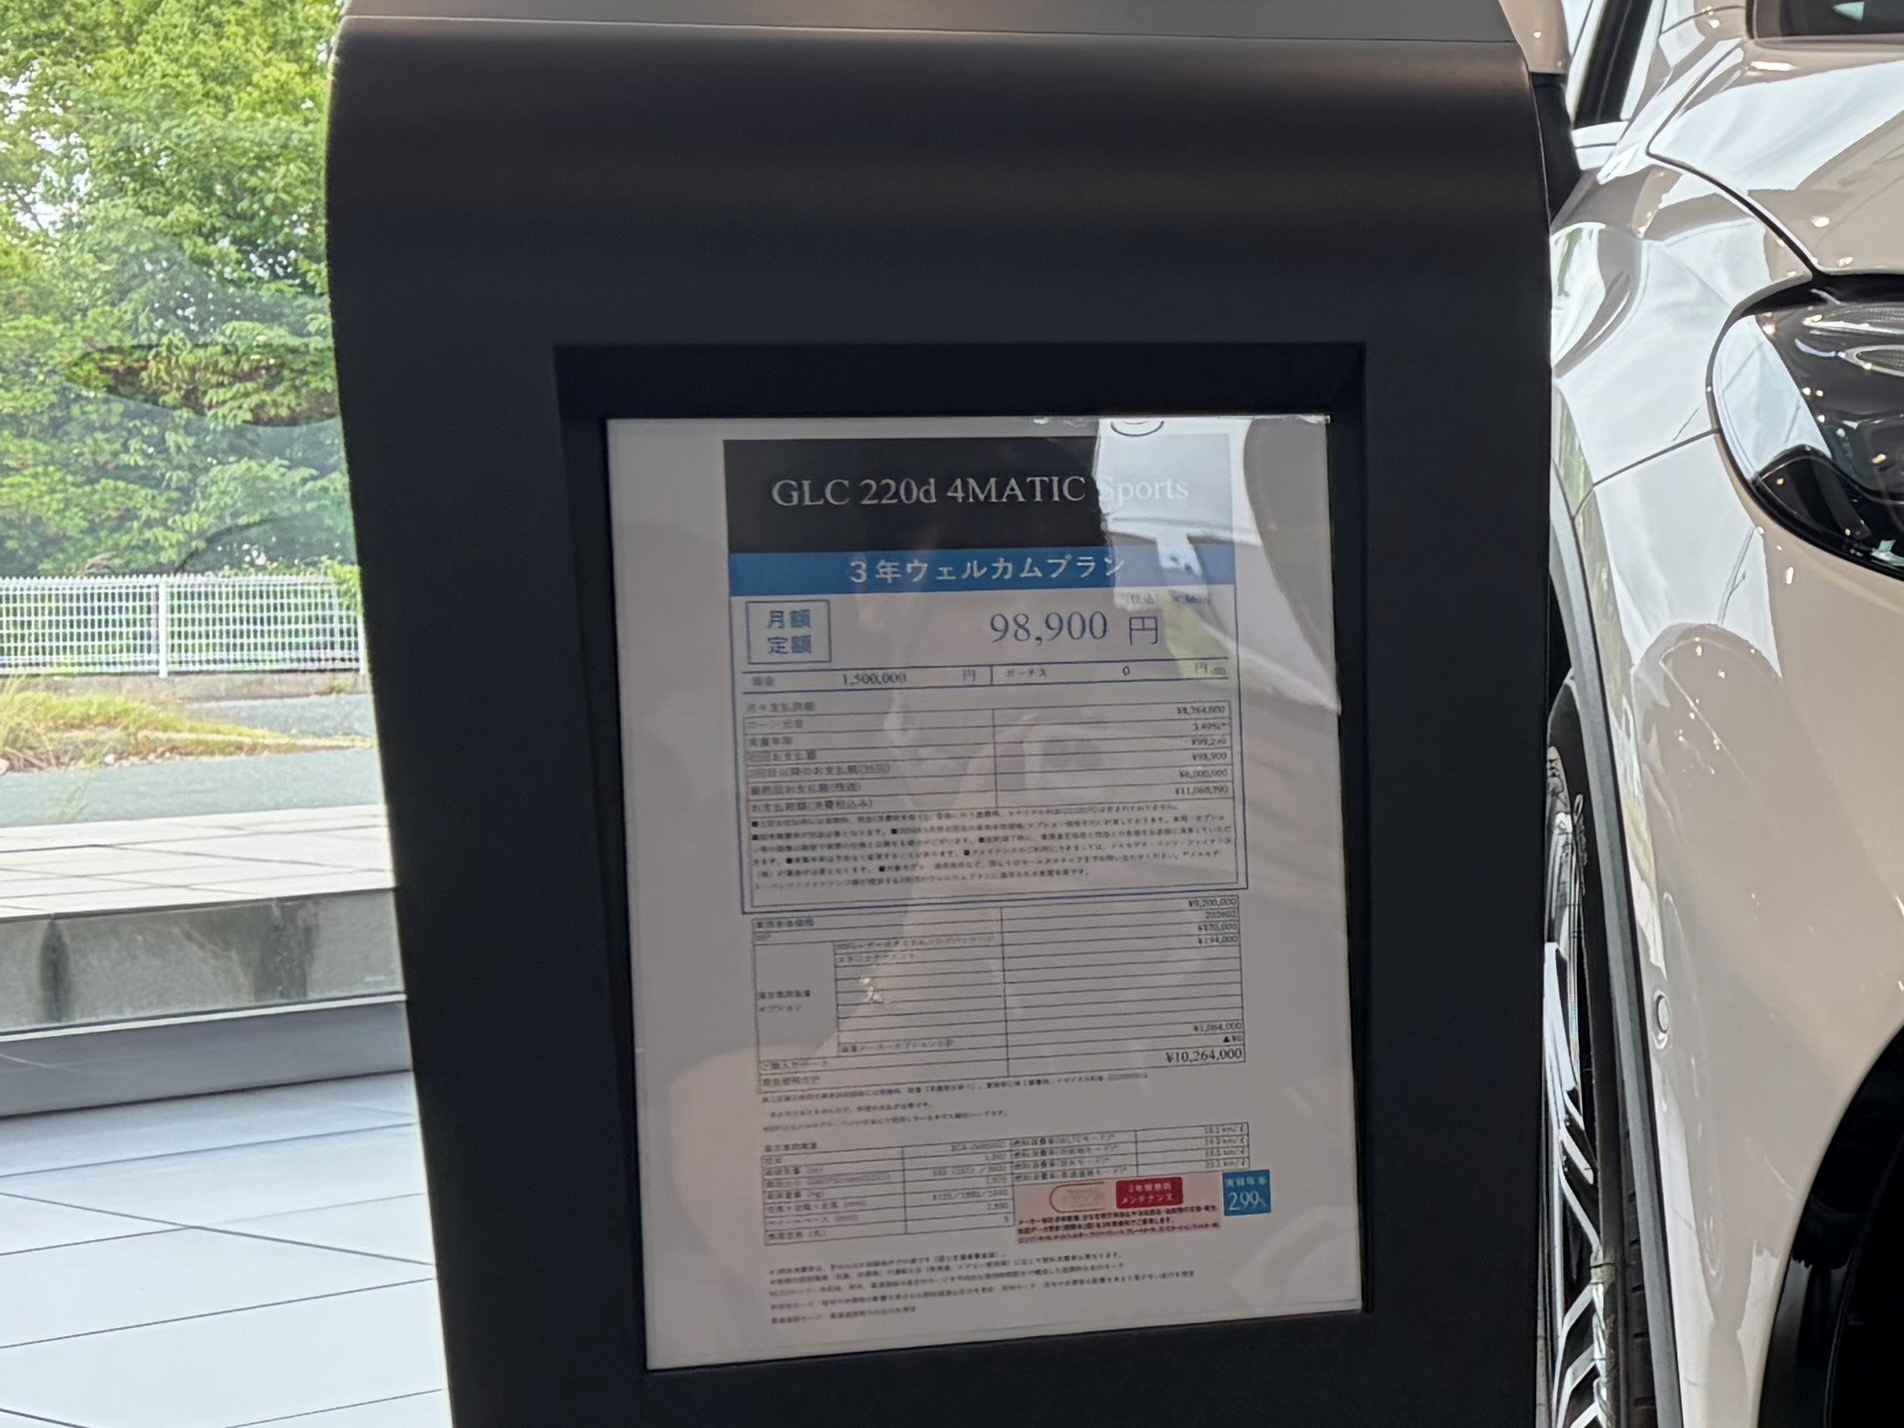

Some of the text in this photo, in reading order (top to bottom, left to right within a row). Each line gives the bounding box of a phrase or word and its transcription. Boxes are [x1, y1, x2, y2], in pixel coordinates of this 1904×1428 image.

[771, 474, 1190, 508] GLC 220d 4MATIC Sports
[767, 609, 812, 630] 月額
[989, 610, 1159, 647] 98,900 円
[767, 634, 812, 655] 定額
[1121, 665, 1131, 677] 0
[1165, 1047, 1243, 1064] ¥10,264,000
